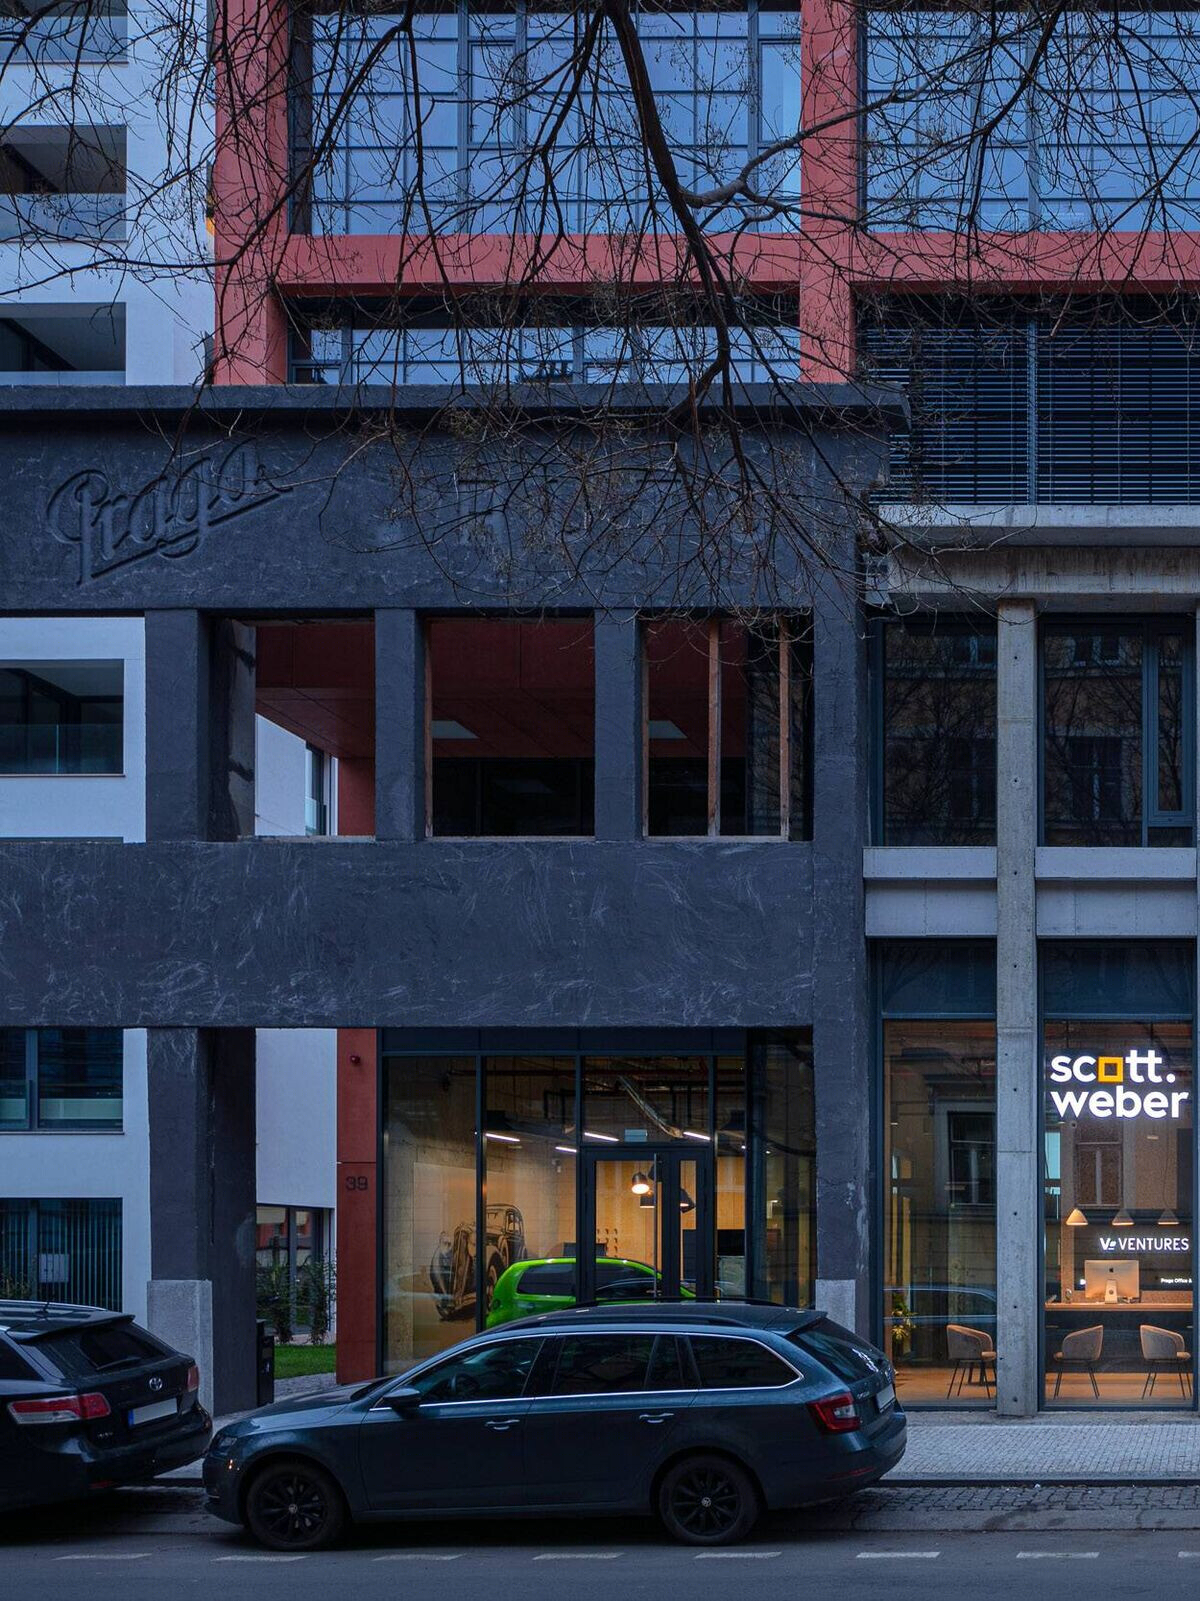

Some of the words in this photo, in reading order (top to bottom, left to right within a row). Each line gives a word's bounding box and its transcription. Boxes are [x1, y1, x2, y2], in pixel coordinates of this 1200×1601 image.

[45, 437, 293, 586] Praga
[1050, 1085, 1189, 1118] weber
[346, 1176, 368, 1191] 39
[1118, 1238, 1189, 1251] VENTURES
